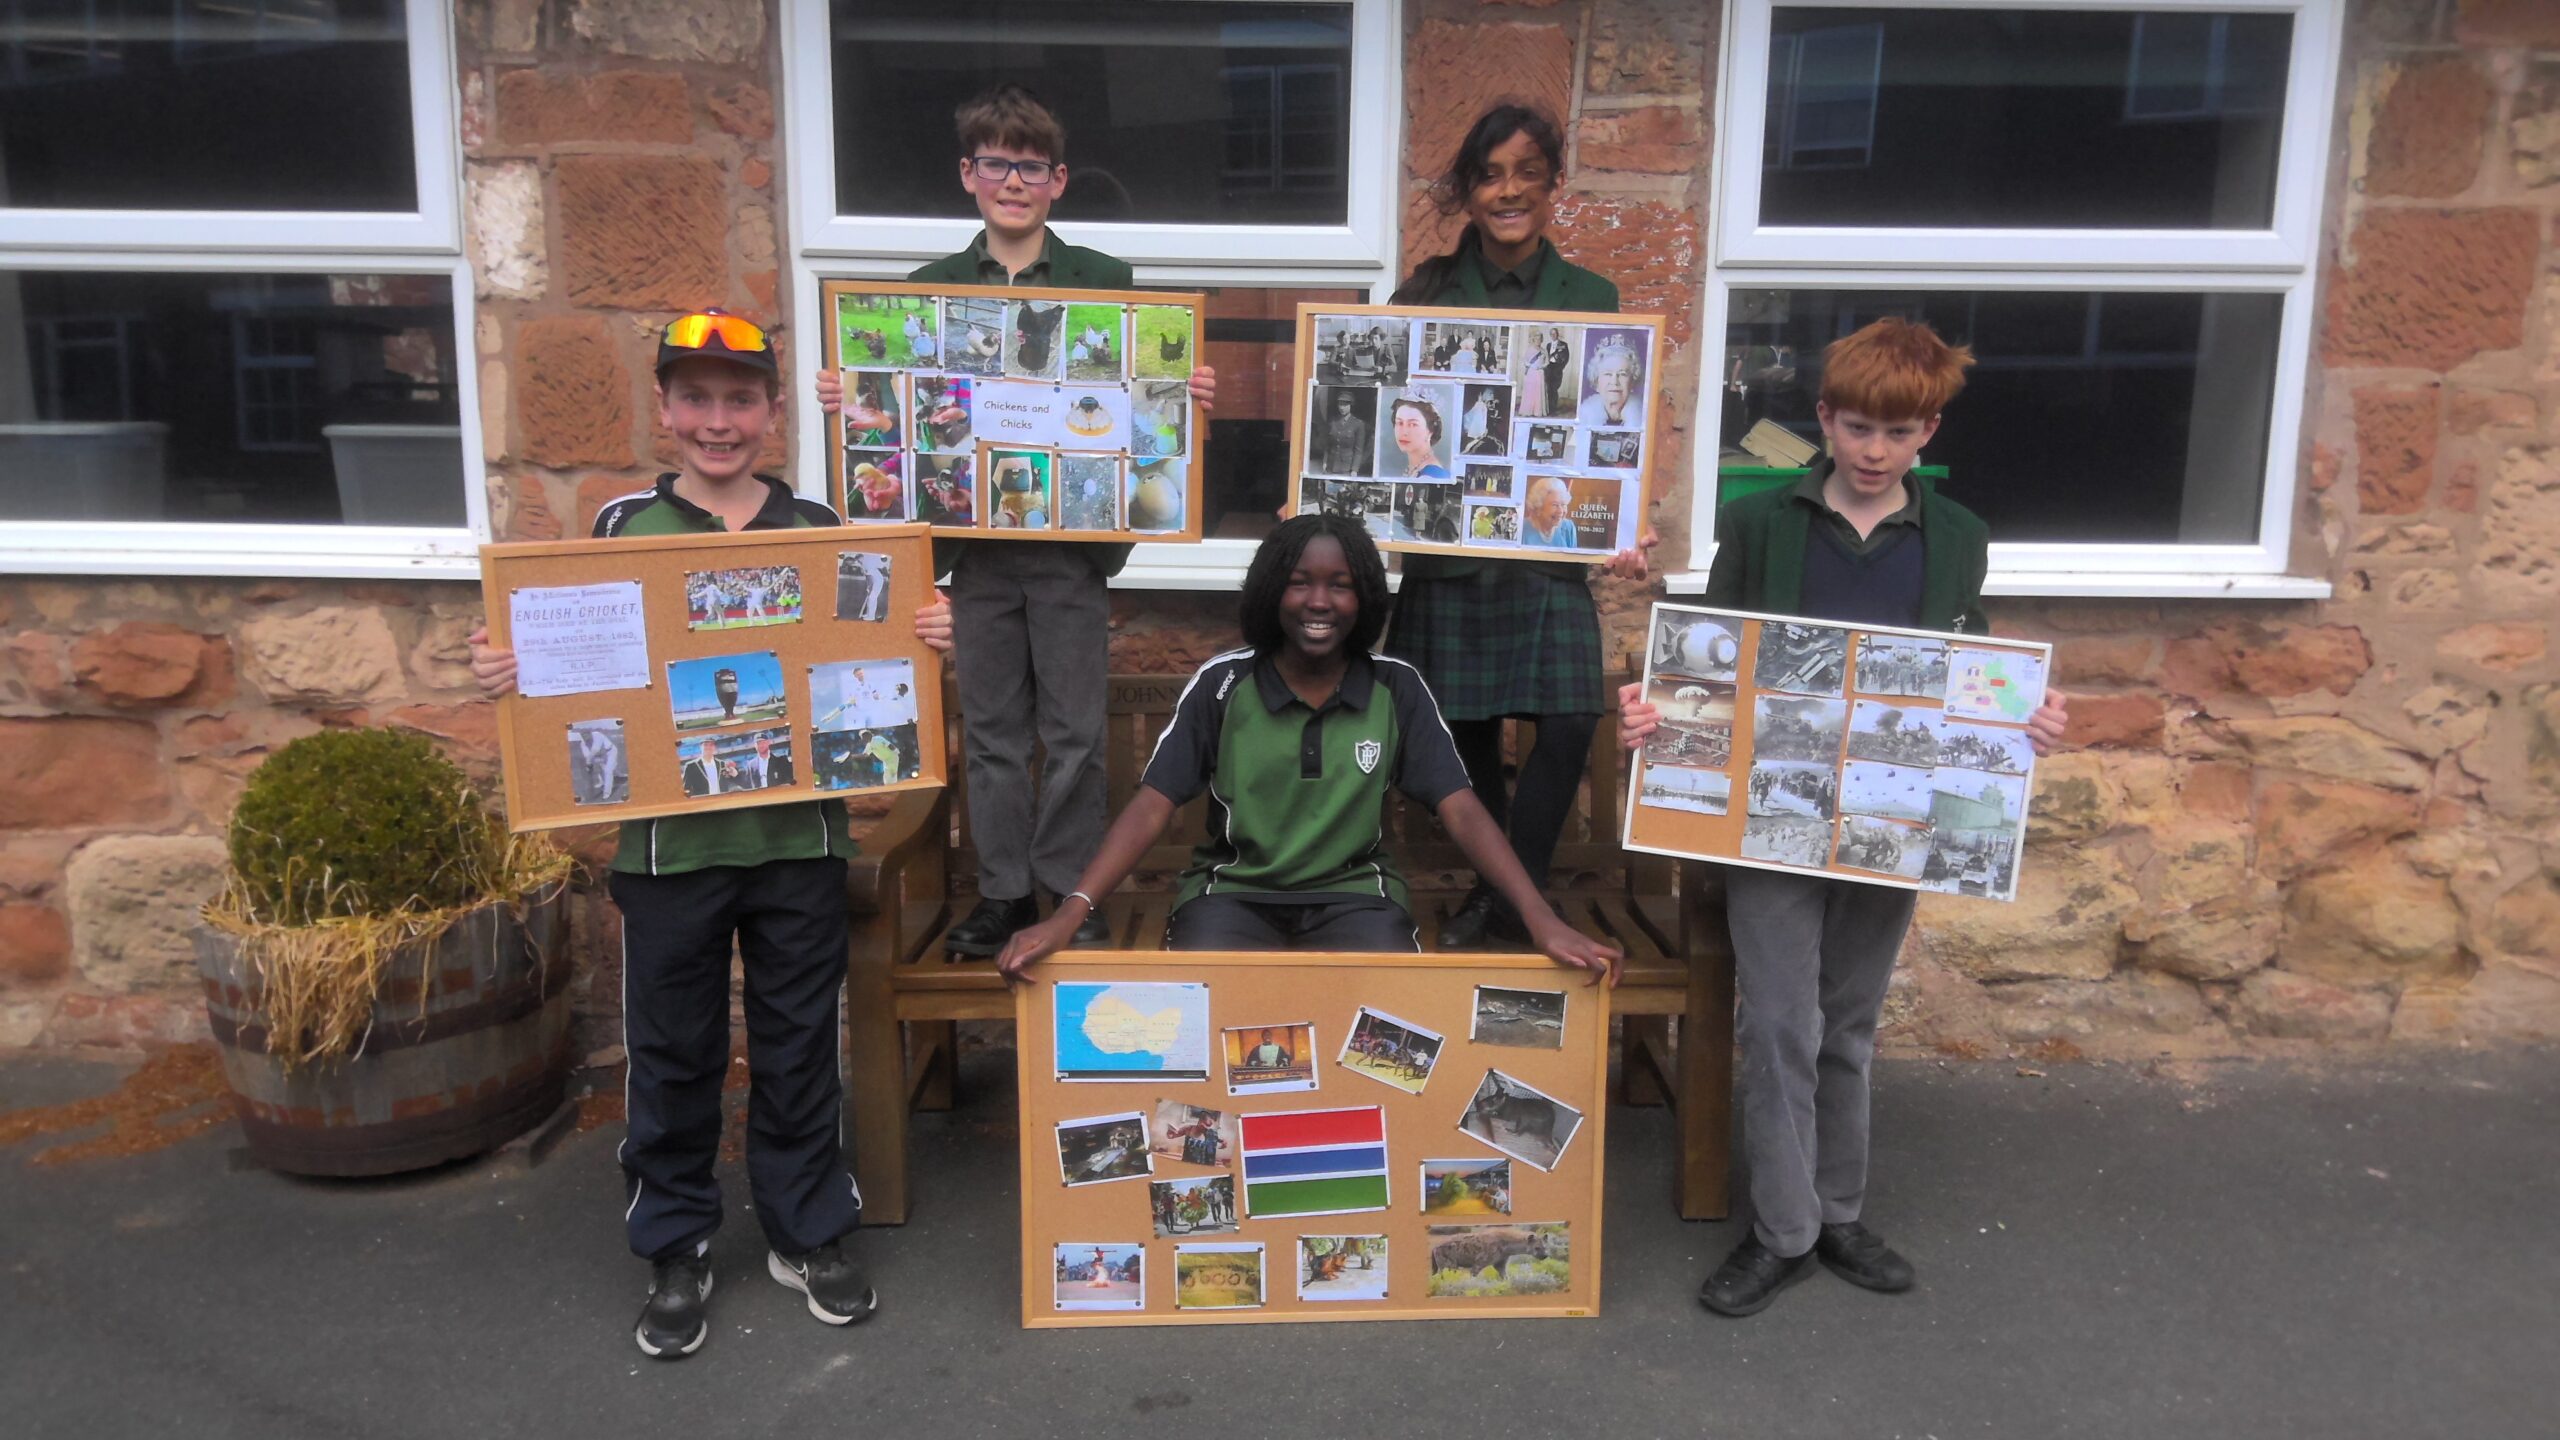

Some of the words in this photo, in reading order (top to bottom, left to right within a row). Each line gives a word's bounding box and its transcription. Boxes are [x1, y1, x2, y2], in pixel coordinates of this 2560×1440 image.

[984, 401, 1028, 413] Chickens
[1031, 404, 1050, 414] and
[1001, 419, 1033, 430] Chicks
[1578, 503, 1607, 512] QUEEN
[1571, 510, 1614, 520] ELIZABETH
[515, 607, 572, 622] ENGLISH
